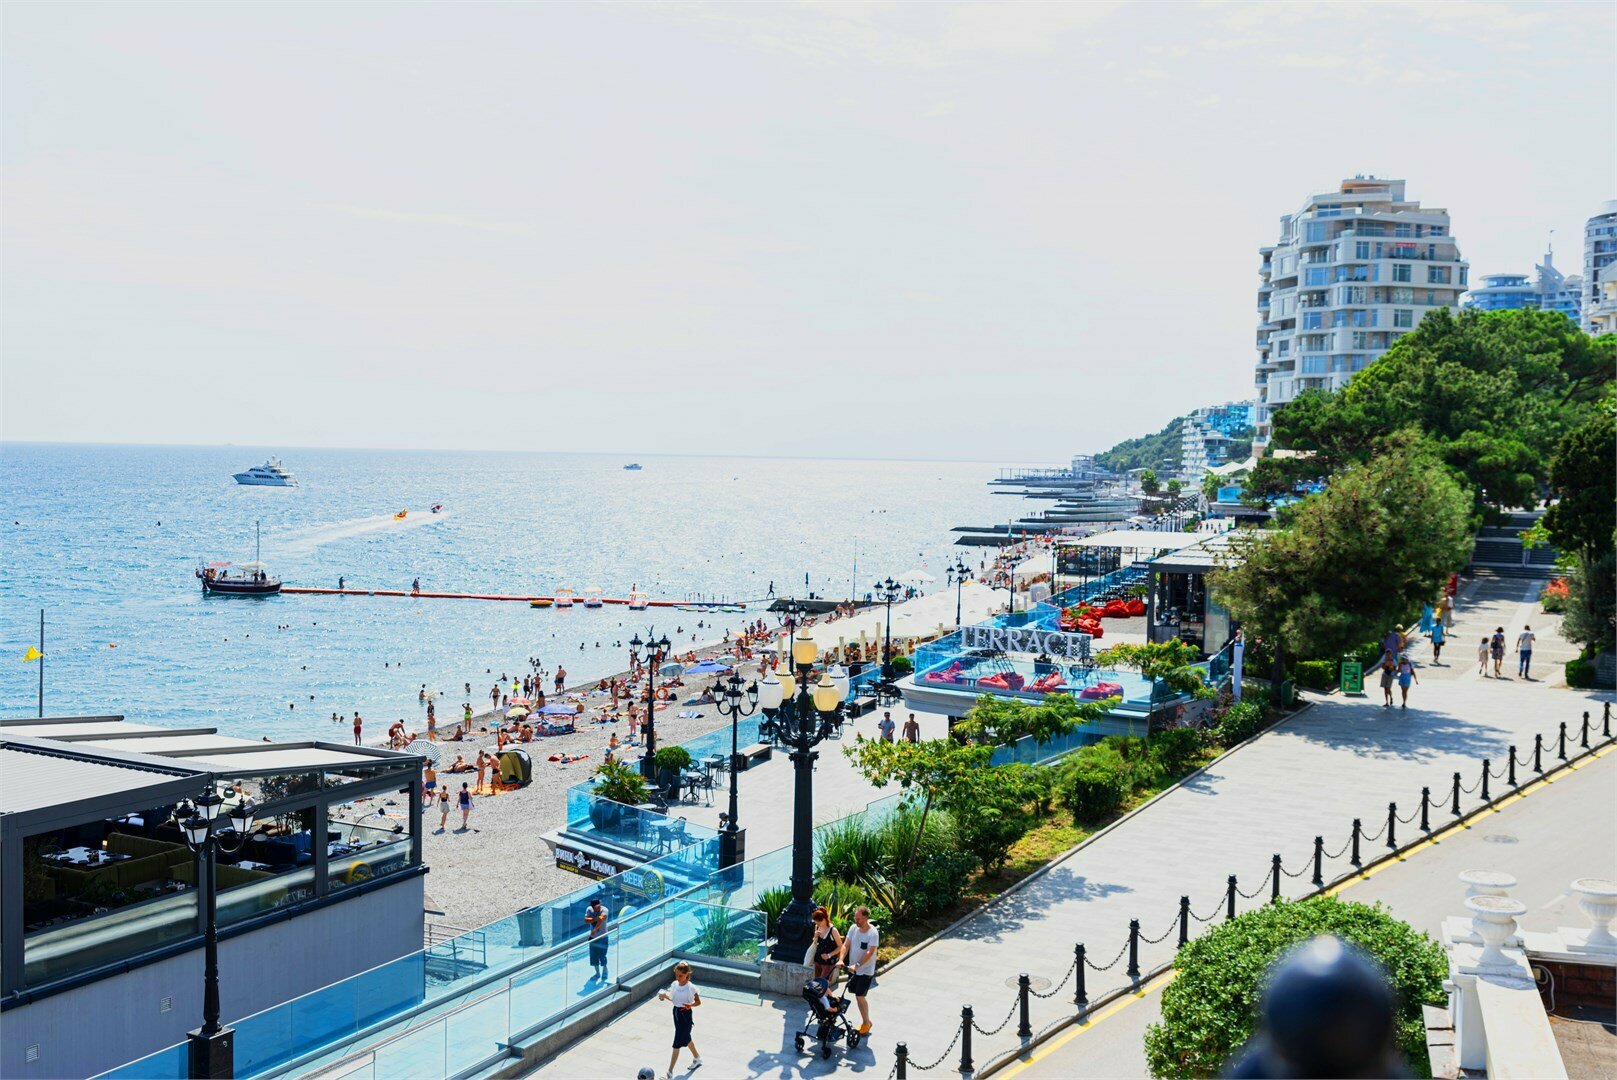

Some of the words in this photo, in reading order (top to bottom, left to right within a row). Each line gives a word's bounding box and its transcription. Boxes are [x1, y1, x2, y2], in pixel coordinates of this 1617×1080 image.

[957, 625, 1083, 658] TERRACE
[555, 848, 575, 864] ВИНА
[590, 859, 618, 877] КРЫМА
